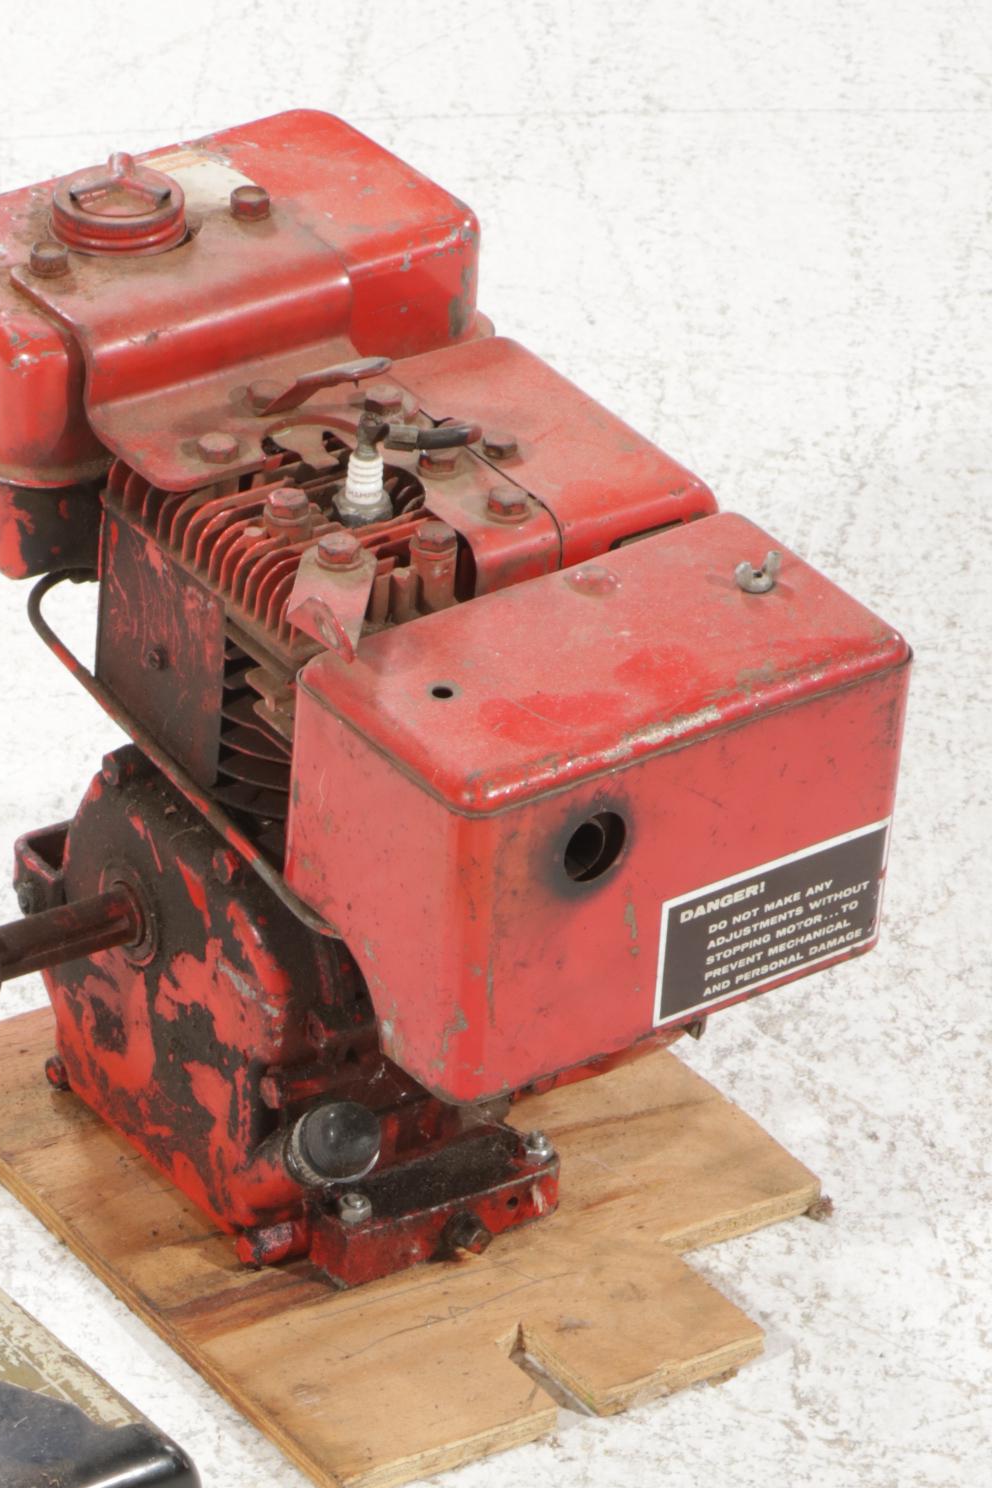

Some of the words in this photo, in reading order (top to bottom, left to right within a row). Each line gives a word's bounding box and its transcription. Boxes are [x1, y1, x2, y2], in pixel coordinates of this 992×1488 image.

[680, 881, 765, 923] DANGER!
[705, 933, 771, 965] STOPPING
[841, 900, 859, 913] TO
[707, 906, 804, 950] ADJUSTMENTS
[808, 880, 870, 910] WITHOUT
[708, 920, 728, 934] DO
[732, 907, 760, 925] NOT
[764, 891, 801, 913] MAKE
[805, 879, 833, 897] ANY
[703, 979, 731, 997] AND
[735, 952, 804, 984] PERSONAL
[808, 928, 863, 956] DAMAGE
[704, 951, 764, 981] PREVENT
[767, 919, 851, 957] MECHANICAL
